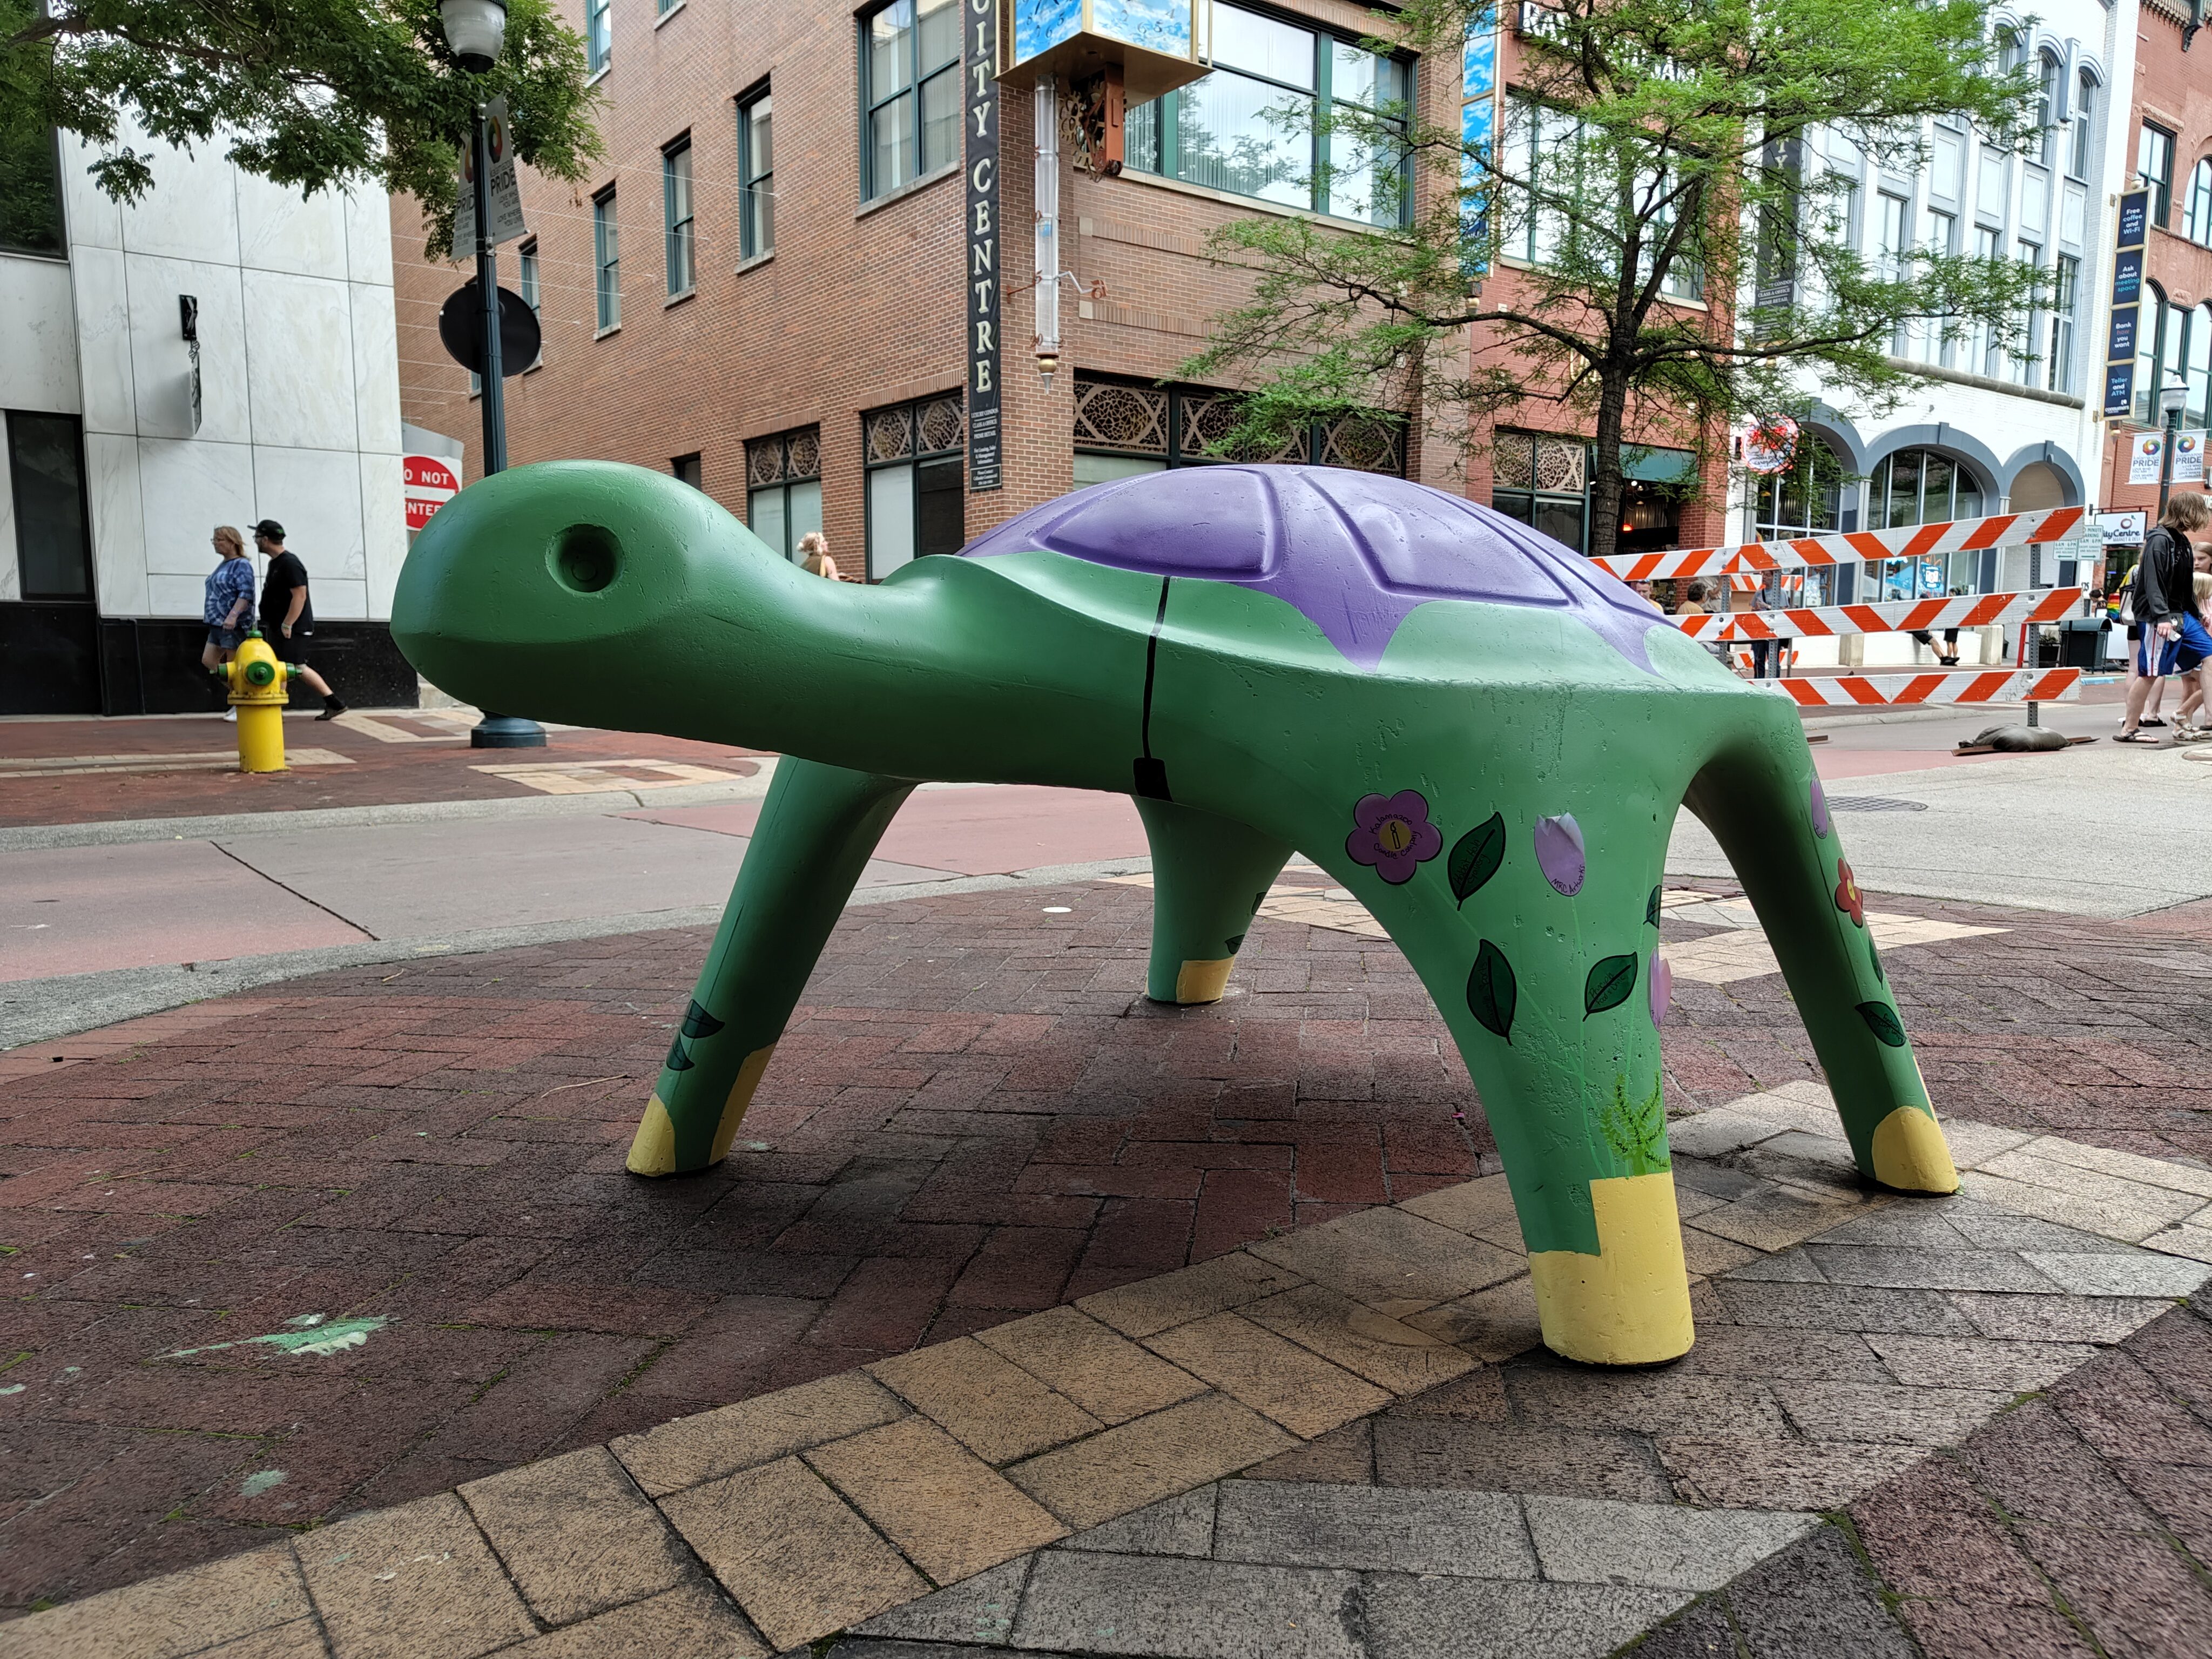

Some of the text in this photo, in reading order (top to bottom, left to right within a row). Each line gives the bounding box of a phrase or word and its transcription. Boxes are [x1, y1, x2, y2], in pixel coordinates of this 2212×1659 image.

[490, 167, 516, 197] PRIDE
[455, 194, 475, 217] PRID
[2123, 214, 2142, 222] coffee
[2126, 220, 2139, 228] and
[2123, 226, 2140, 234] Wi-Fi
[973, 158, 994, 393] CENTRE
[2119, 271, 2137, 279] about
[2115, 278, 2140, 286] meeting
[2117, 284, 2136, 293] space
[2111, 389, 2126, 397] ATM
[2176, 456, 2202, 464] PRIDE
[404, 469, 449, 485] O NOT
[2103, 529, 2141, 539] ityCentre
[1368, 813, 1413, 835] Kalamazoo
[1400, 831, 1422, 857] Company
[1373, 842, 1399, 859] Candle
[1551, 878, 1568, 893] MRC
